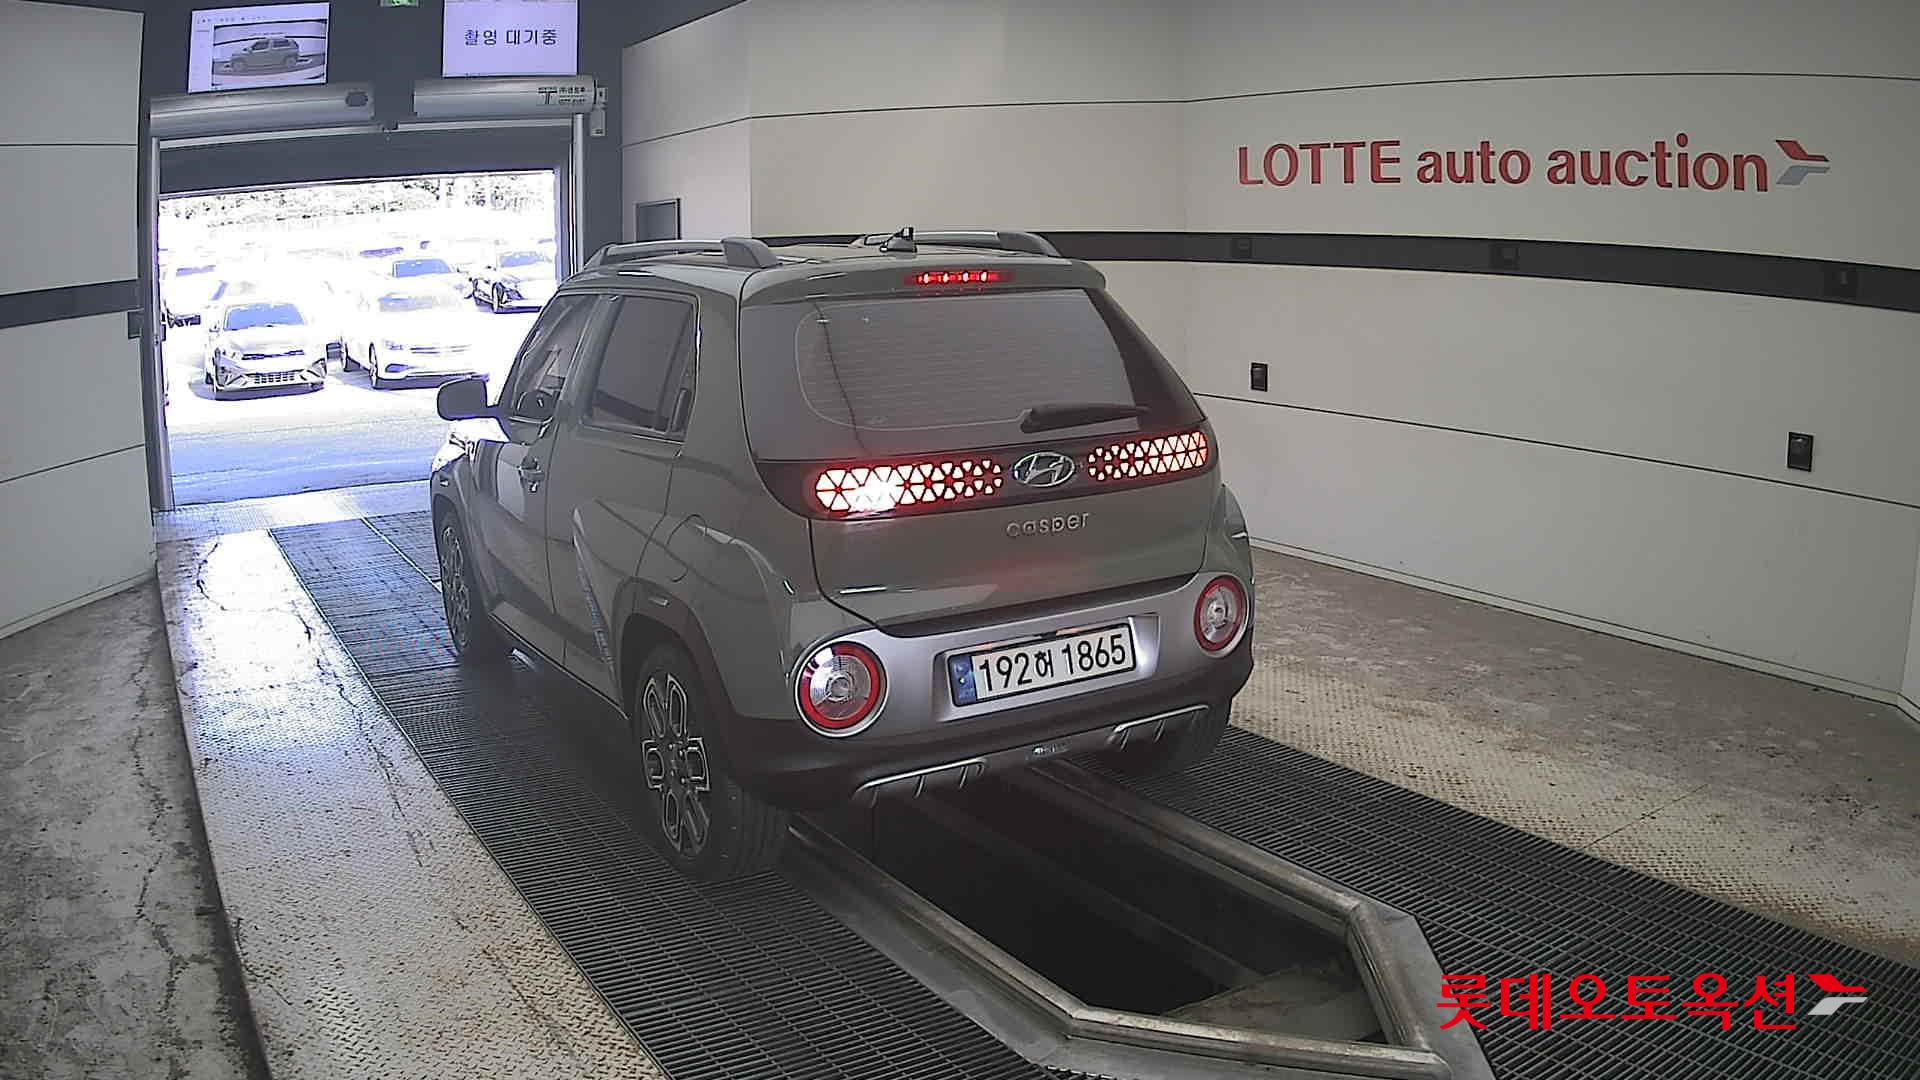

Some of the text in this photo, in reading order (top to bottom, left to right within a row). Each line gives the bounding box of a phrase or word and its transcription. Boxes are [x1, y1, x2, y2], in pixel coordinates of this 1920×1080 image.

[465, 29, 557, 46] 촬영 대기중
[1239, 133, 1769, 192] LOTTE auto auction
[1006, 512, 1089, 537] casper
[1062, 634, 1126, 675] 1865
